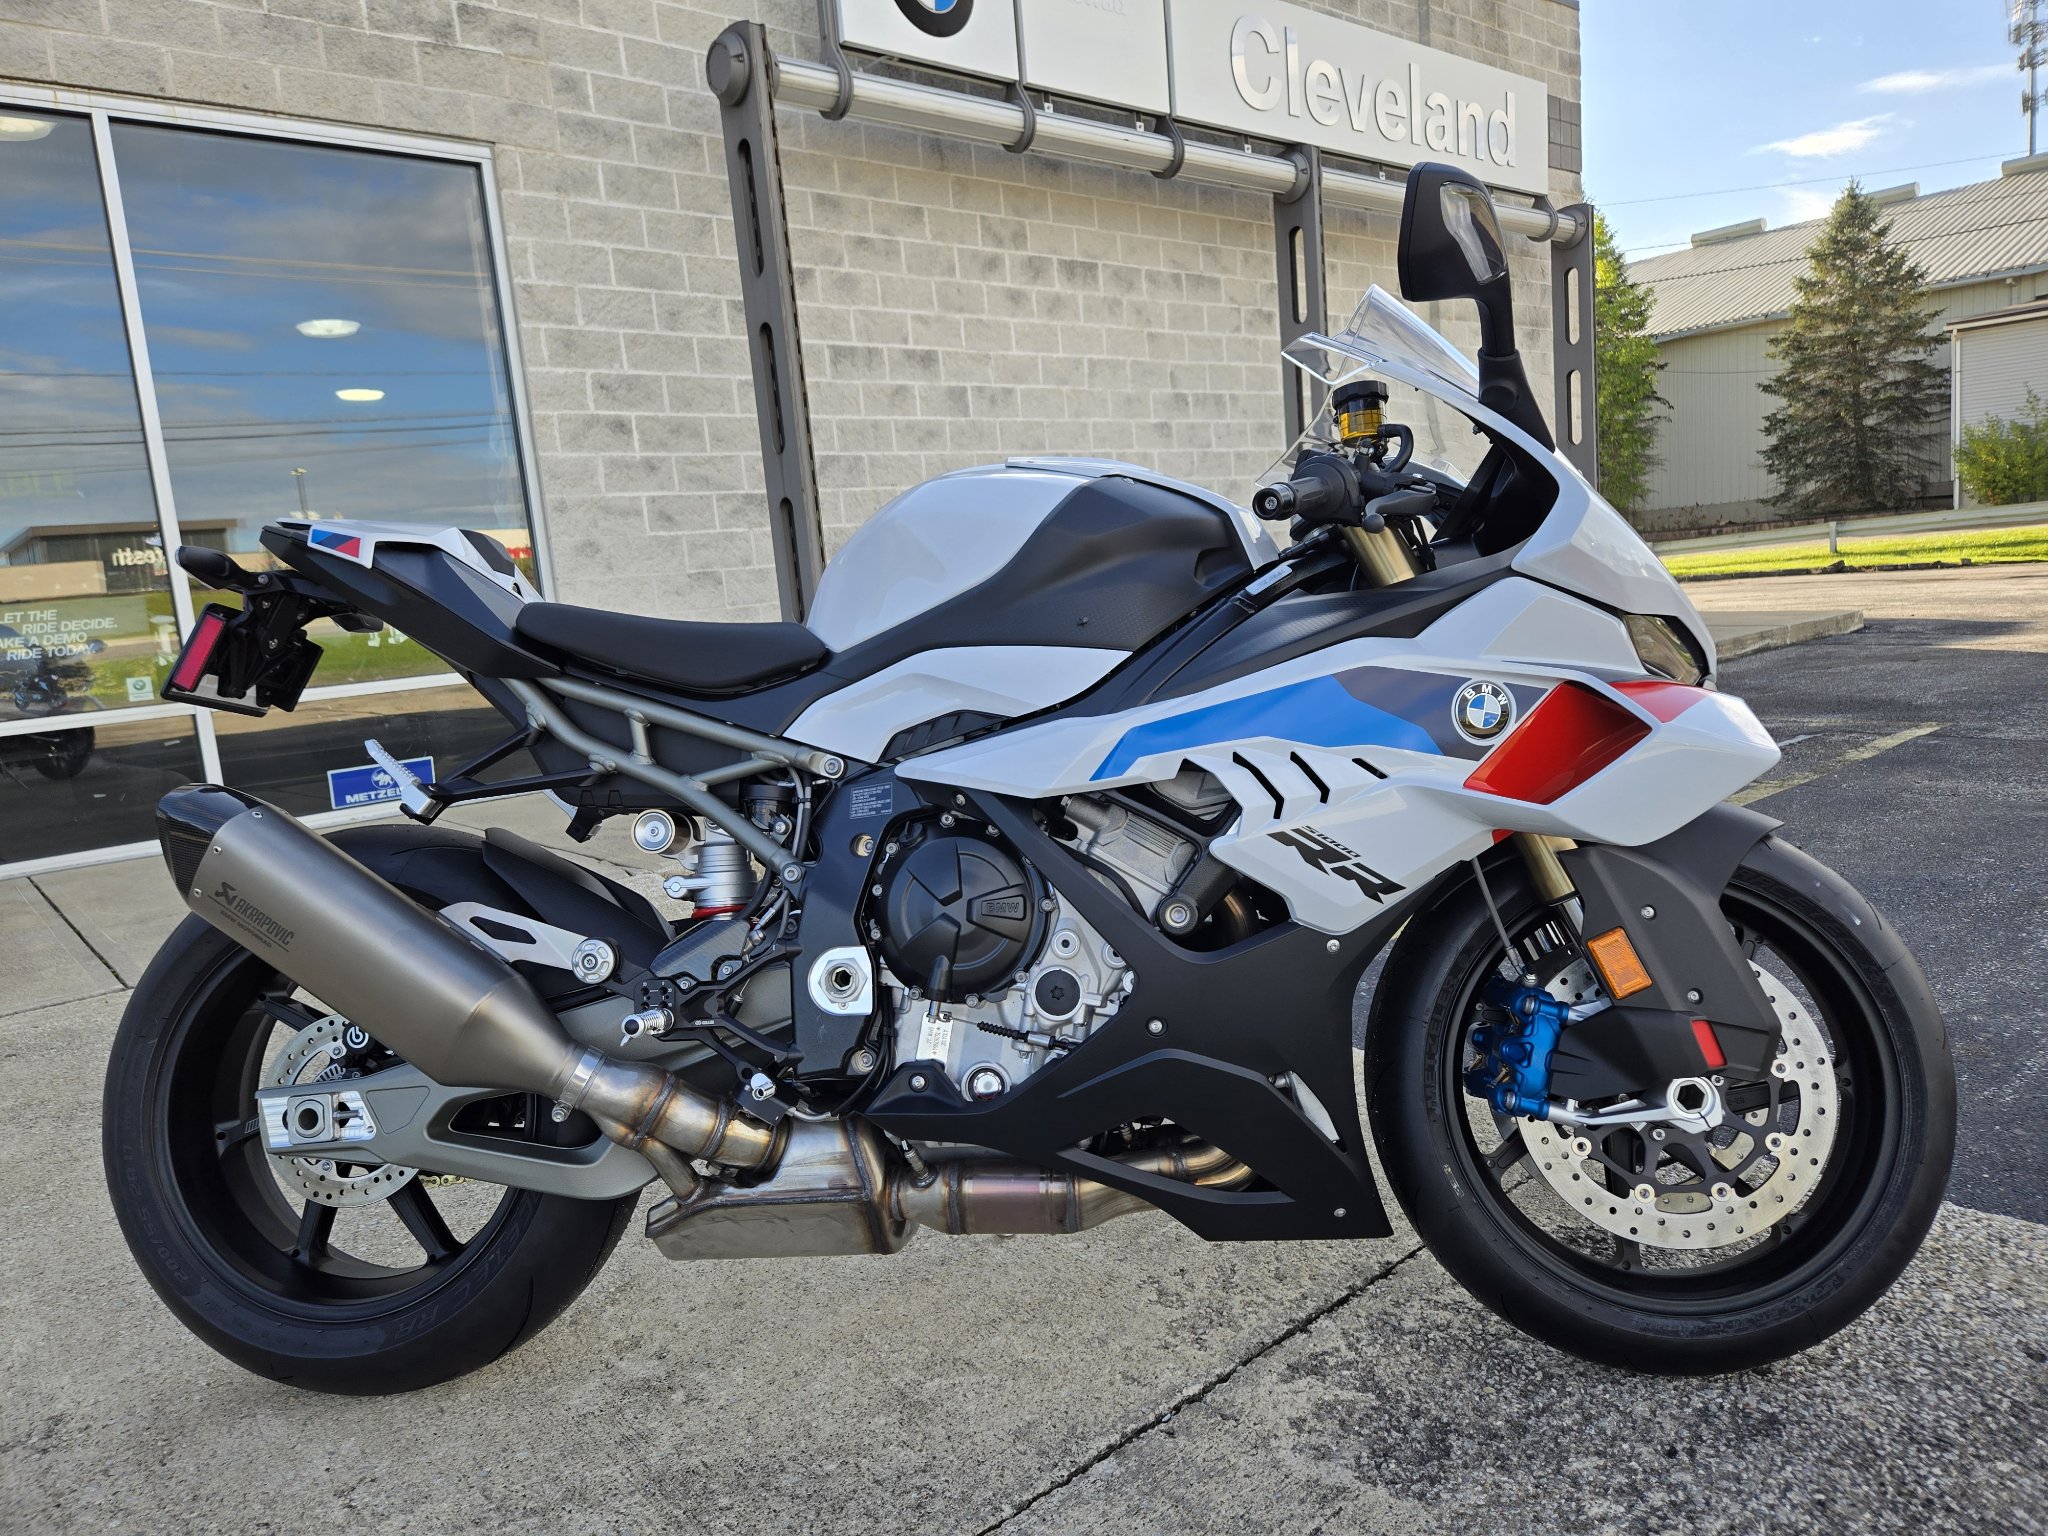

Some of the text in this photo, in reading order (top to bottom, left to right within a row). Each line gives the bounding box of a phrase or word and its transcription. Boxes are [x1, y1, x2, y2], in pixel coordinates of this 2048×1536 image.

[1230, 15, 1516, 167] Cleveland
[27, 609, 58, 622] THE
[22, 617, 118, 635] RIDE DECIDE.
[28, 635, 39, 647] A
[43, 632, 88, 645] DEMO
[7, 648, 42, 661] RIDE
[1464, 684, 1508, 705] BMW
[1301, 825, 1361, 858] S1000
[1266, 828, 1406, 905] RR
[986, 902, 1019, 913] BMW
